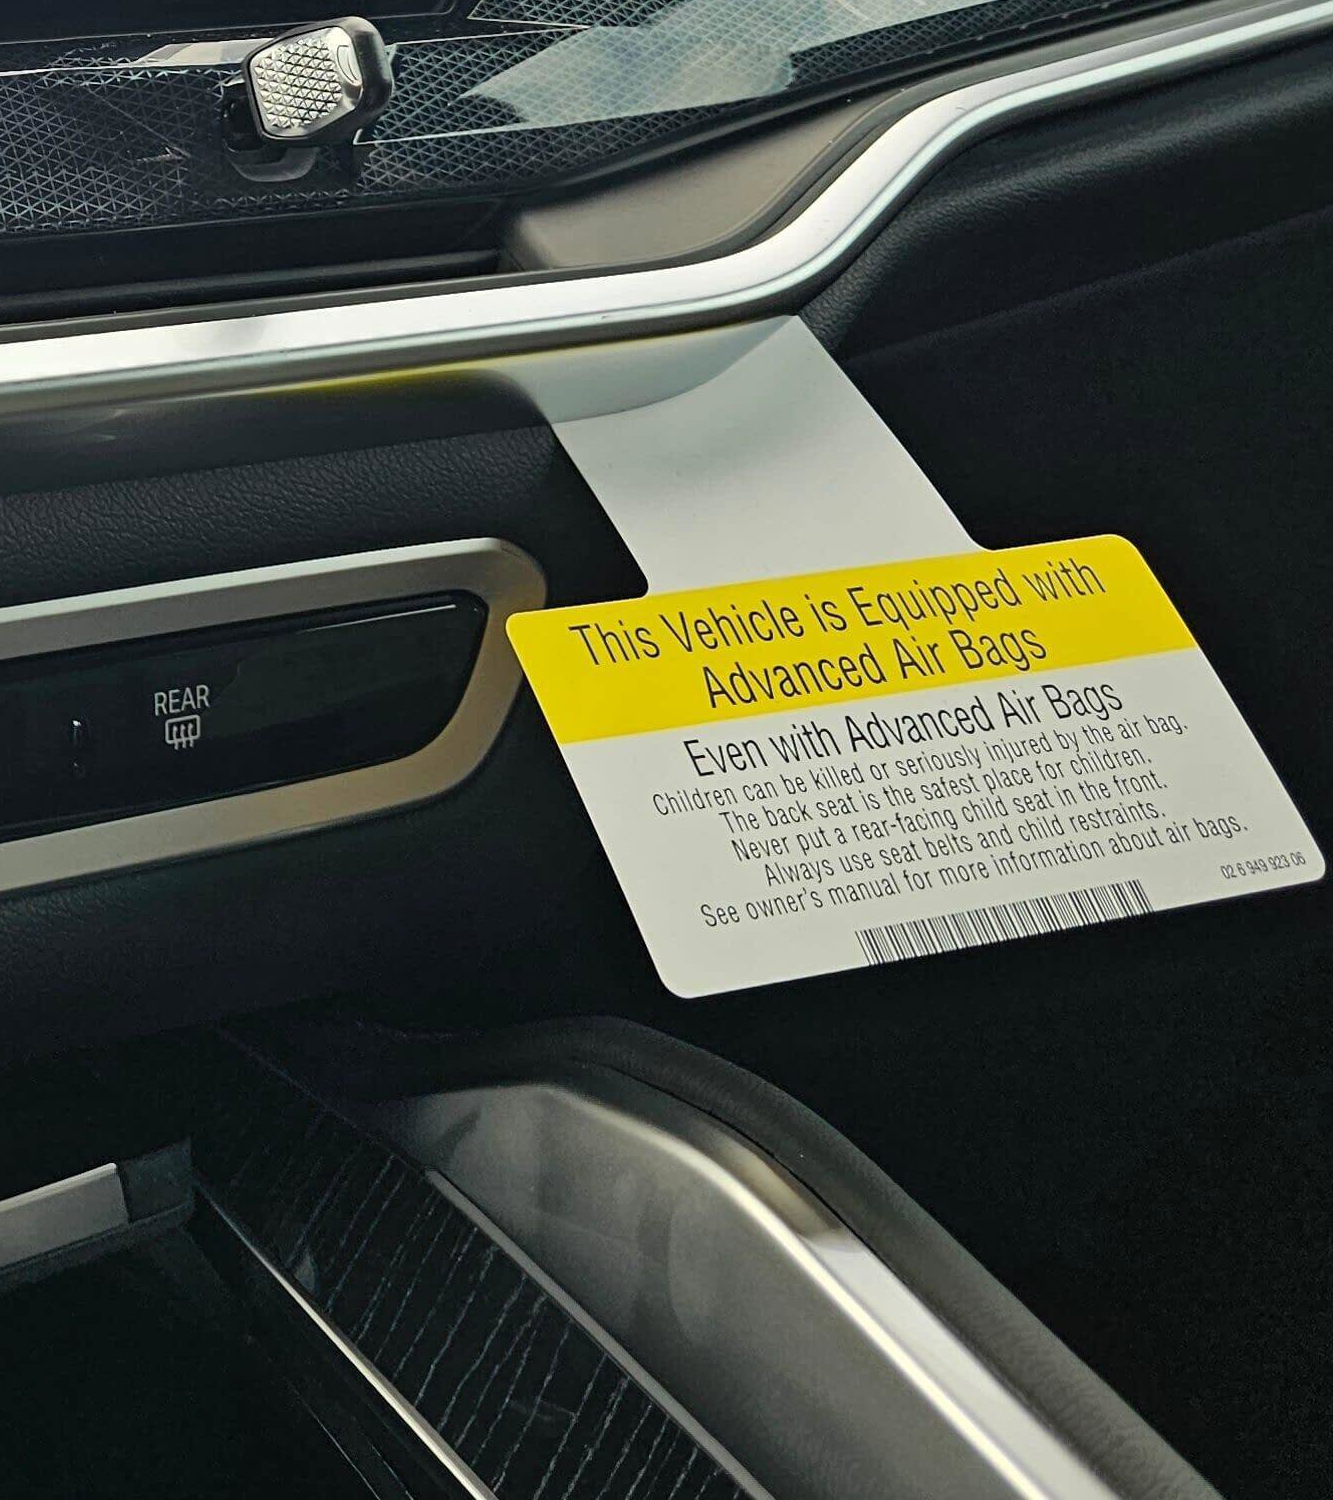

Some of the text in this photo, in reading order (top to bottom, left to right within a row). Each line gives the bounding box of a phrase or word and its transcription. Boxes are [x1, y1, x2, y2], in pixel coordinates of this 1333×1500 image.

[567, 557, 1106, 666] This Vehicle is Equipped with
[152, 682, 211, 713] REAR
[702, 628, 1047, 709] Advanced Air Bags
[652, 714, 1189, 816] Children can be killed or seriously injured by the air bag.
[682, 683, 1123, 778] Even with Advanced Air Bags
[718, 748, 1153, 834] The back seat is the safest place for children.
[730, 769, 1168, 862] Never put a rear-facing child seat in the front.
[700, 903, 741, 928] See
[827, 871, 901, 906] manual
[902, 869, 933, 892] for
[937, 861, 990, 886] more
[989, 839, 1106, 877] information
[1108, 826, 1165, 856] about
[1165, 821, 1191, 844] air
[1192, 815, 1249, 839] bags.
[764, 799, 1166, 888] Always use seat belts and child restraints.
